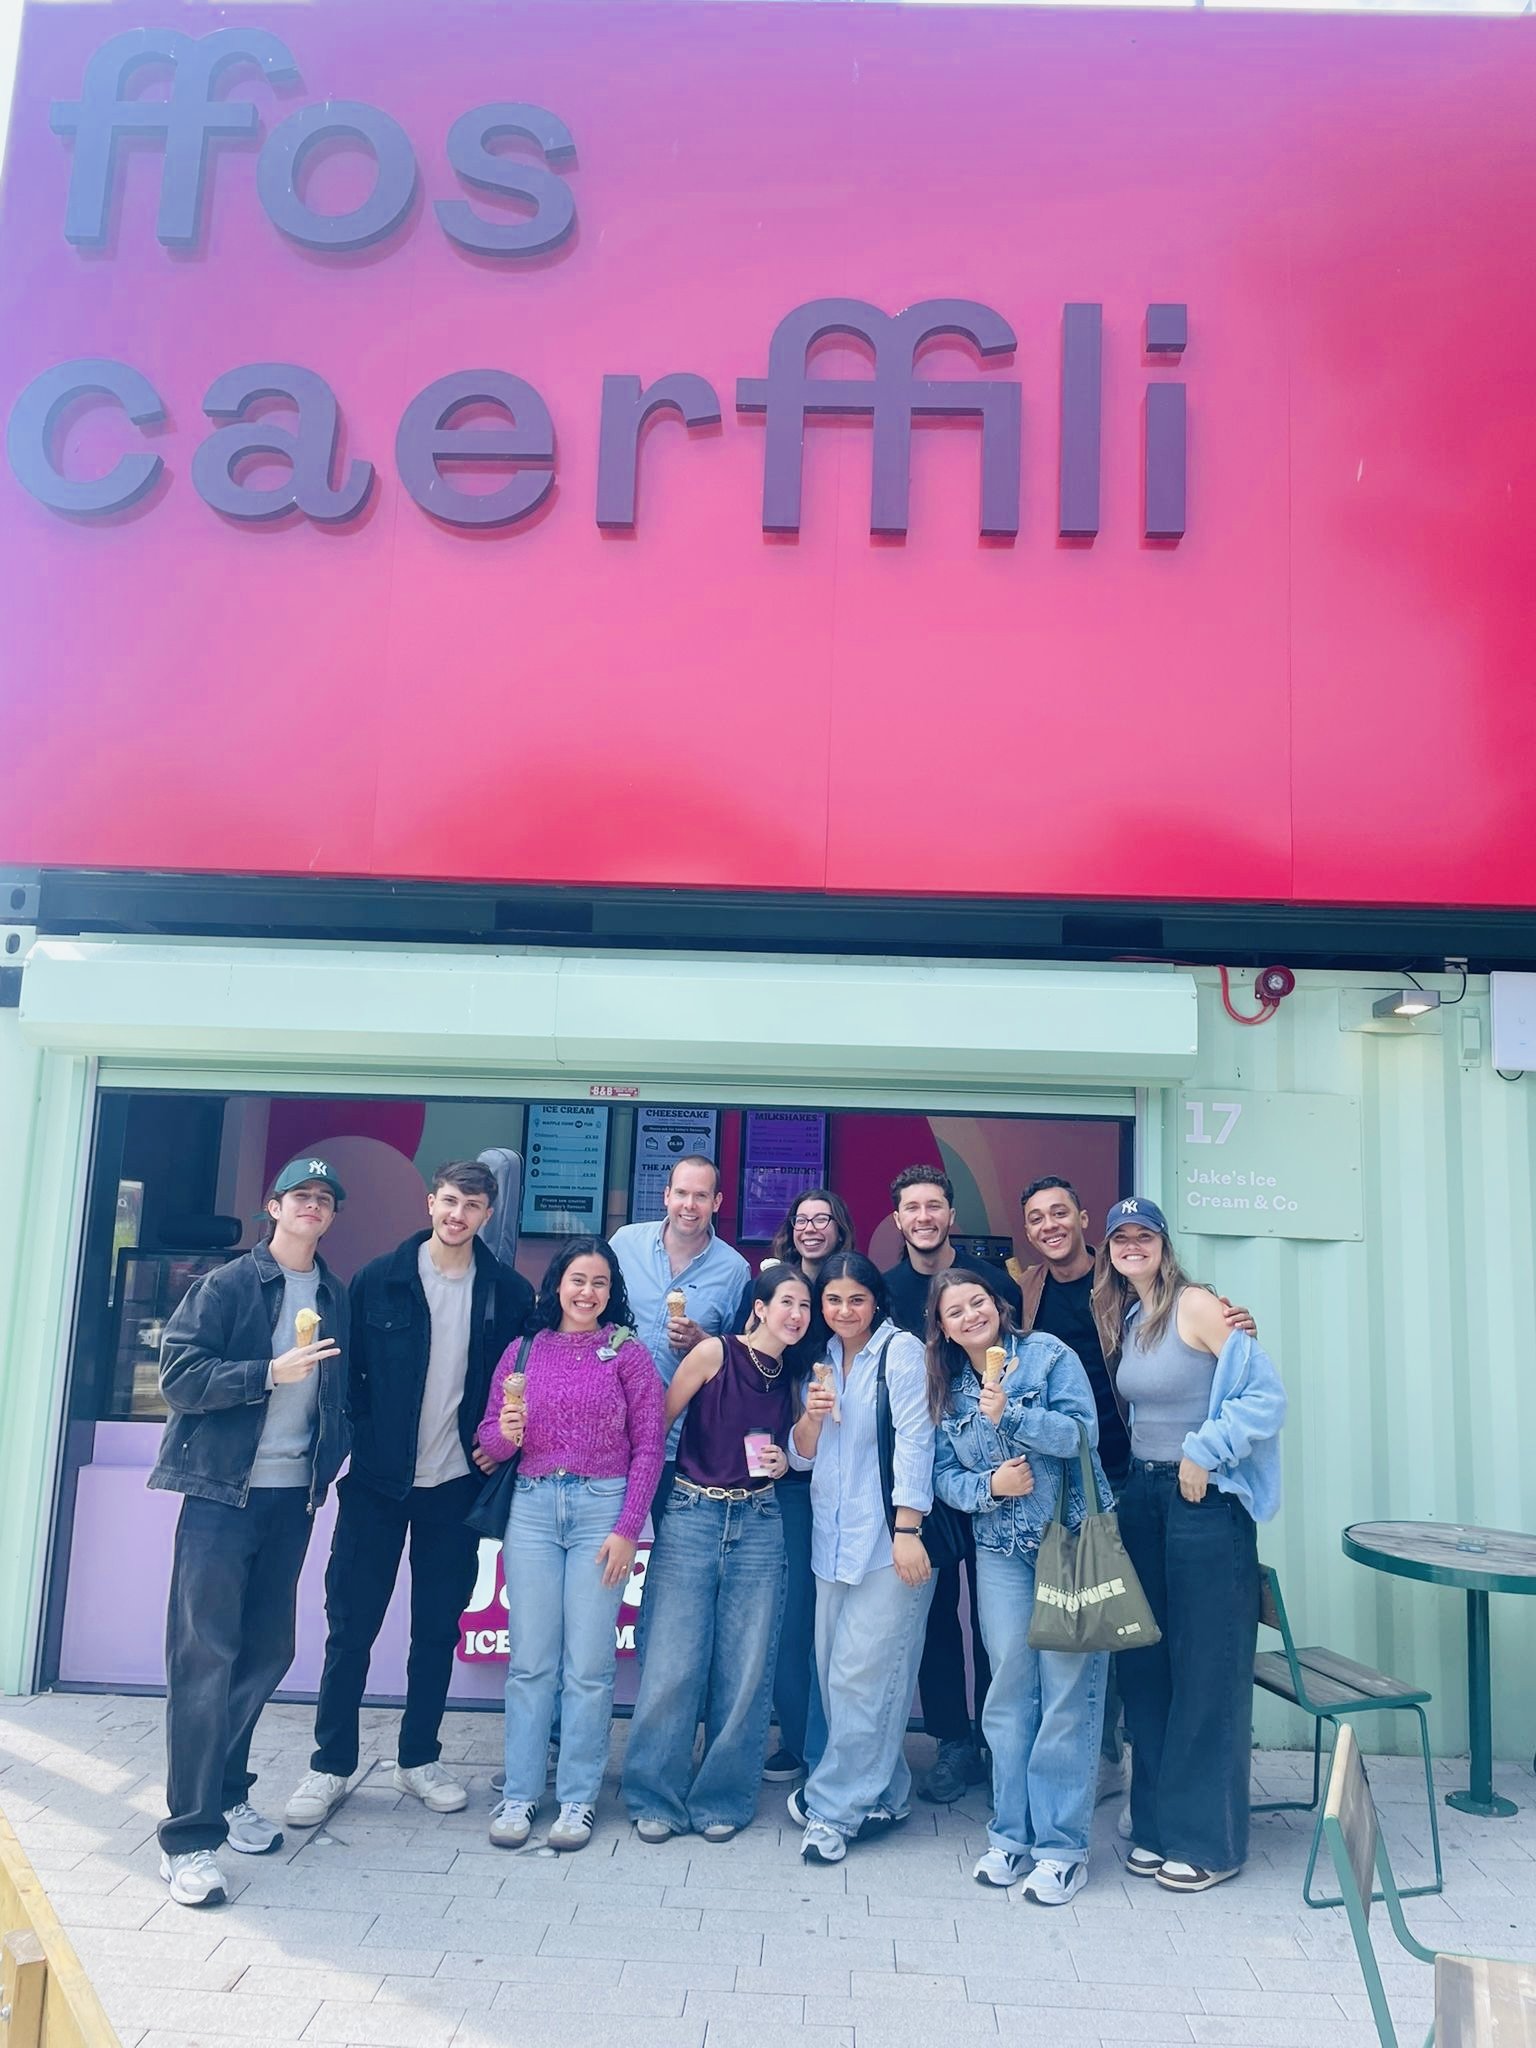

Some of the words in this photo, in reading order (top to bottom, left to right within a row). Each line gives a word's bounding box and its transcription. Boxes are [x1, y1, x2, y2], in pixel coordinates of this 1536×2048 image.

[49, 26, 577, 258] ffos
[6, 297, 1187, 540] caerffili
[542, 1106, 558, 1114] ICE
[560, 1106, 595, 1115] CREAM
[646, 1109, 709, 1118] CHEESECAKE
[755, 1112, 818, 1121] MILKSHAKES
[1185, 1102, 1242, 1145] 17
[308, 1160, 328, 1176] NY
[641, 1163, 659, 1171] THE
[1187, 1168, 1246, 1187] Jake's
[1250, 1171, 1277, 1187] Ice
[1121, 1199, 1138, 1214] NY
[1187, 1191, 1250, 1209] Cream
[1254, 1194, 1269, 1210] &
[1273, 1195, 1298, 1212] Co
